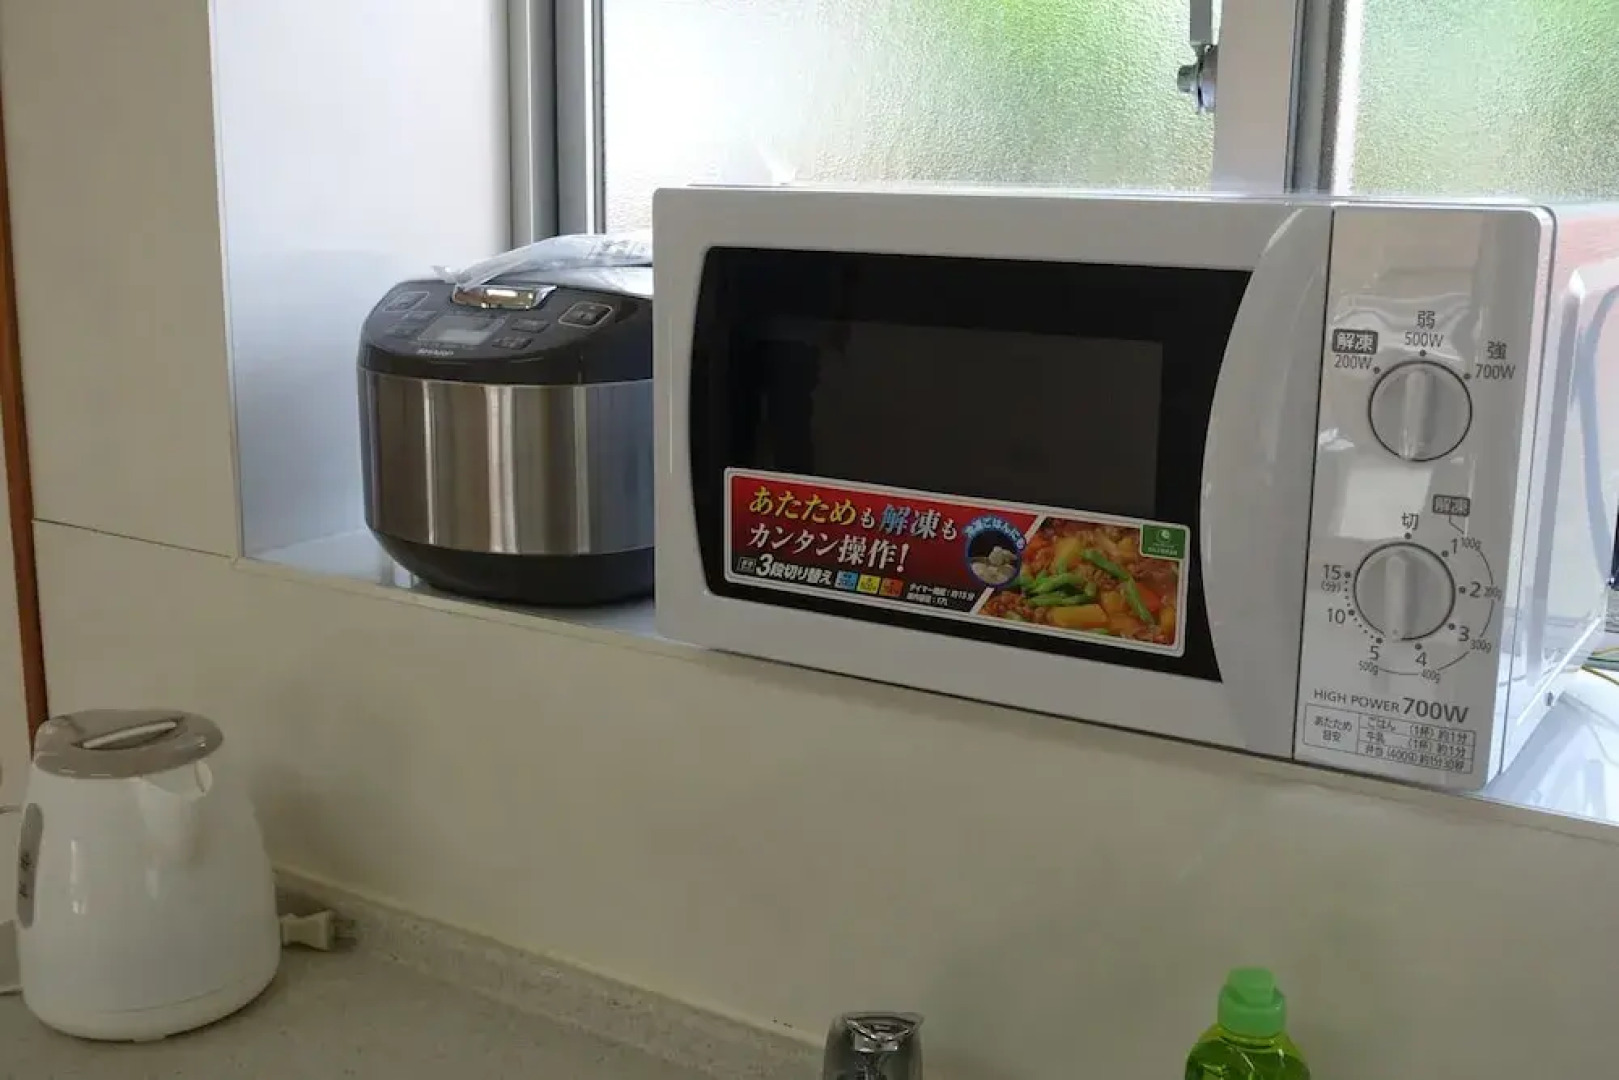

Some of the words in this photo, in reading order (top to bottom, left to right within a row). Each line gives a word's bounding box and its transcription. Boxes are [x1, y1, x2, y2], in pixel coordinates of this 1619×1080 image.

[1417, 311, 1435, 329] 弱
[1334, 330, 1377, 353] 解凍
[1404, 332, 1444, 347] 500W
[1488, 341, 1508, 360] 強
[1334, 355, 1373, 370] 200W
[1475, 364, 1516, 380] 700W
[749, 486, 958, 541] あたためも解凍も
[1402, 512, 1419, 530] 切
[1451, 538, 1458, 554] 1
[1323, 564, 1342, 580] 15
[1469, 581, 1481, 598] 2
[1327, 608, 1346, 623] 10
[1458, 626, 1470, 642] 3
[1370, 645, 1379, 660] 5
[1415, 651, 1427, 666] 4
[1314, 689, 1347, 703] HIGH
[1351, 695, 1400, 713] POWER
[1403, 698, 1469, 723] 700W
